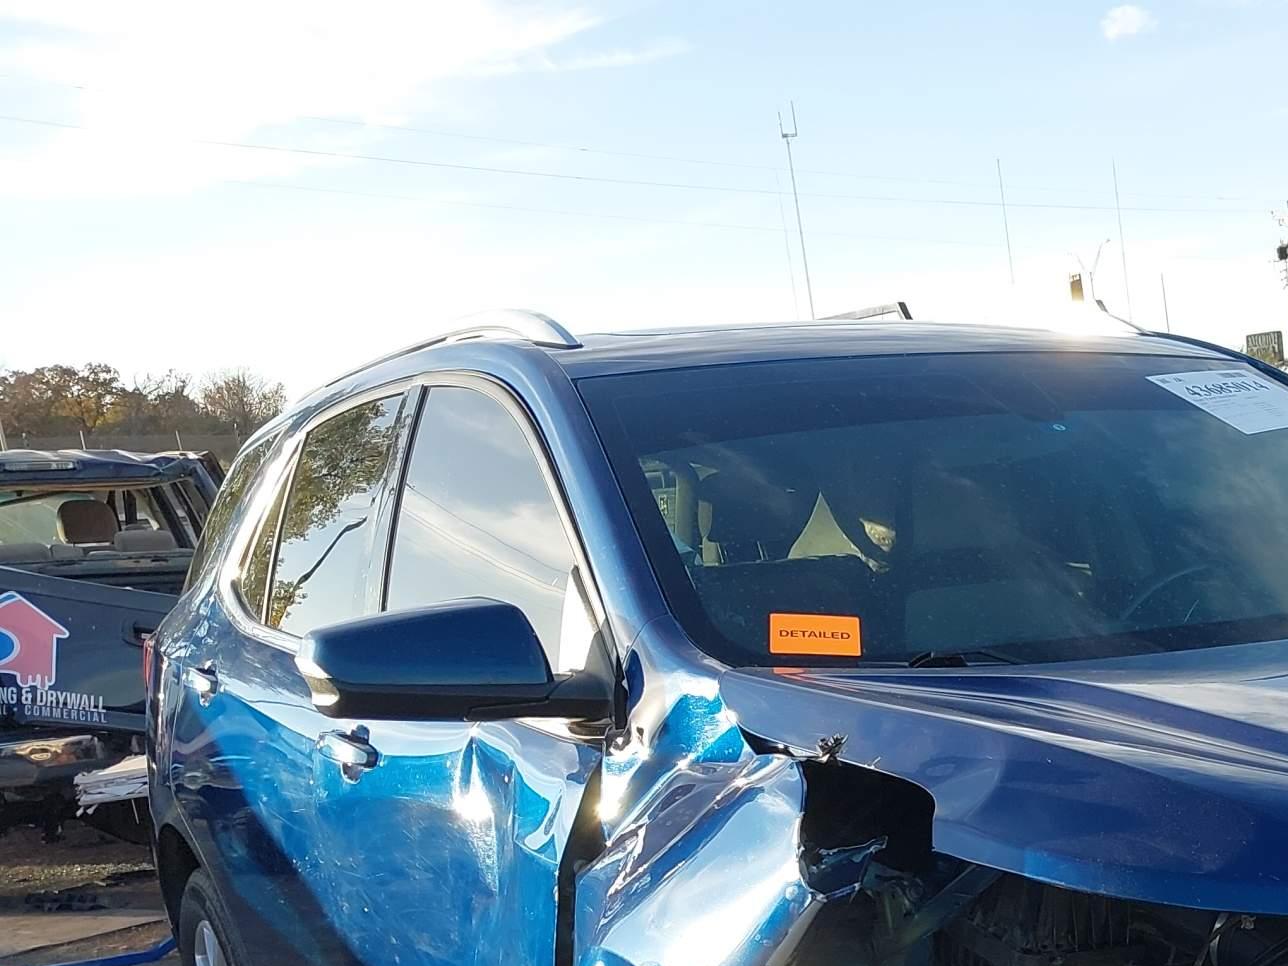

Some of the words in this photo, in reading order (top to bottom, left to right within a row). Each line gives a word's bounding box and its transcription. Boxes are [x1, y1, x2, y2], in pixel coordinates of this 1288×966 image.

[1184, 380, 1271, 397] 43685014
[778, 629, 851, 640] DETAILED
[0, 686, 17, 704] NG
[21, 687, 32, 705] &
[36, 689, 107, 713] DRYWALL
[24, 704, 108, 724] COMMERCIAL
